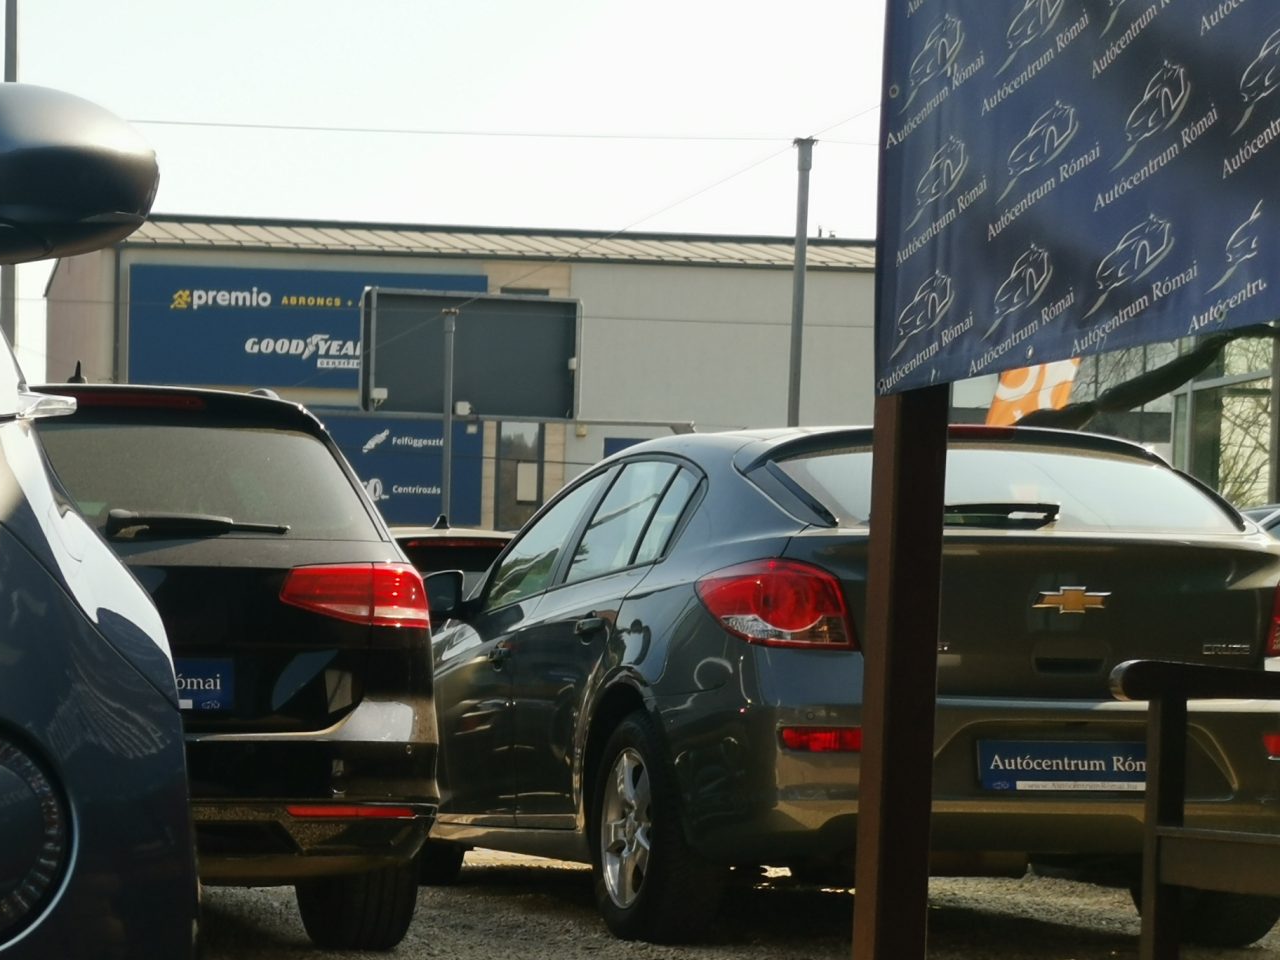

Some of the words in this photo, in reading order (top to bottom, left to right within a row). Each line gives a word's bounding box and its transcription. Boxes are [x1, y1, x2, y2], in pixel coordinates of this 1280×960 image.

[1092, 4, 1157, 79] Autócentrum
[1200, 0, 1245, 36] Autóc
[981, 47, 1055, 116] Autócentrum
[1056, 9, 1089, 52] Római
[886, 86, 948, 149] Autócentrum
[1222, 117, 1280, 179] Autócentr
[1094, 142, 1179, 212] Autócentrum
[1181, 103, 1218, 149] Római
[896, 207, 956, 267] Autócentrum
[957, 174, 987, 214] Római
[988, 176, 1055, 241] Autócentrum
[1059, 142, 1100, 183] Római
[193, 287, 271, 310] premio
[941, 311, 973, 348] Római
[1071, 295, 1149, 357] Autócentrum
[1152, 260, 1198, 301] Római
[969, 320, 1038, 376] Autócentrum
[1041, 287, 1074, 326] Római
[392, 437, 444, 447] Felfüggeszté
[176, 674, 220, 690] ómai
[989, 754, 1106, 771] Autócentrum
[1112, 756, 1146, 771] Róm
